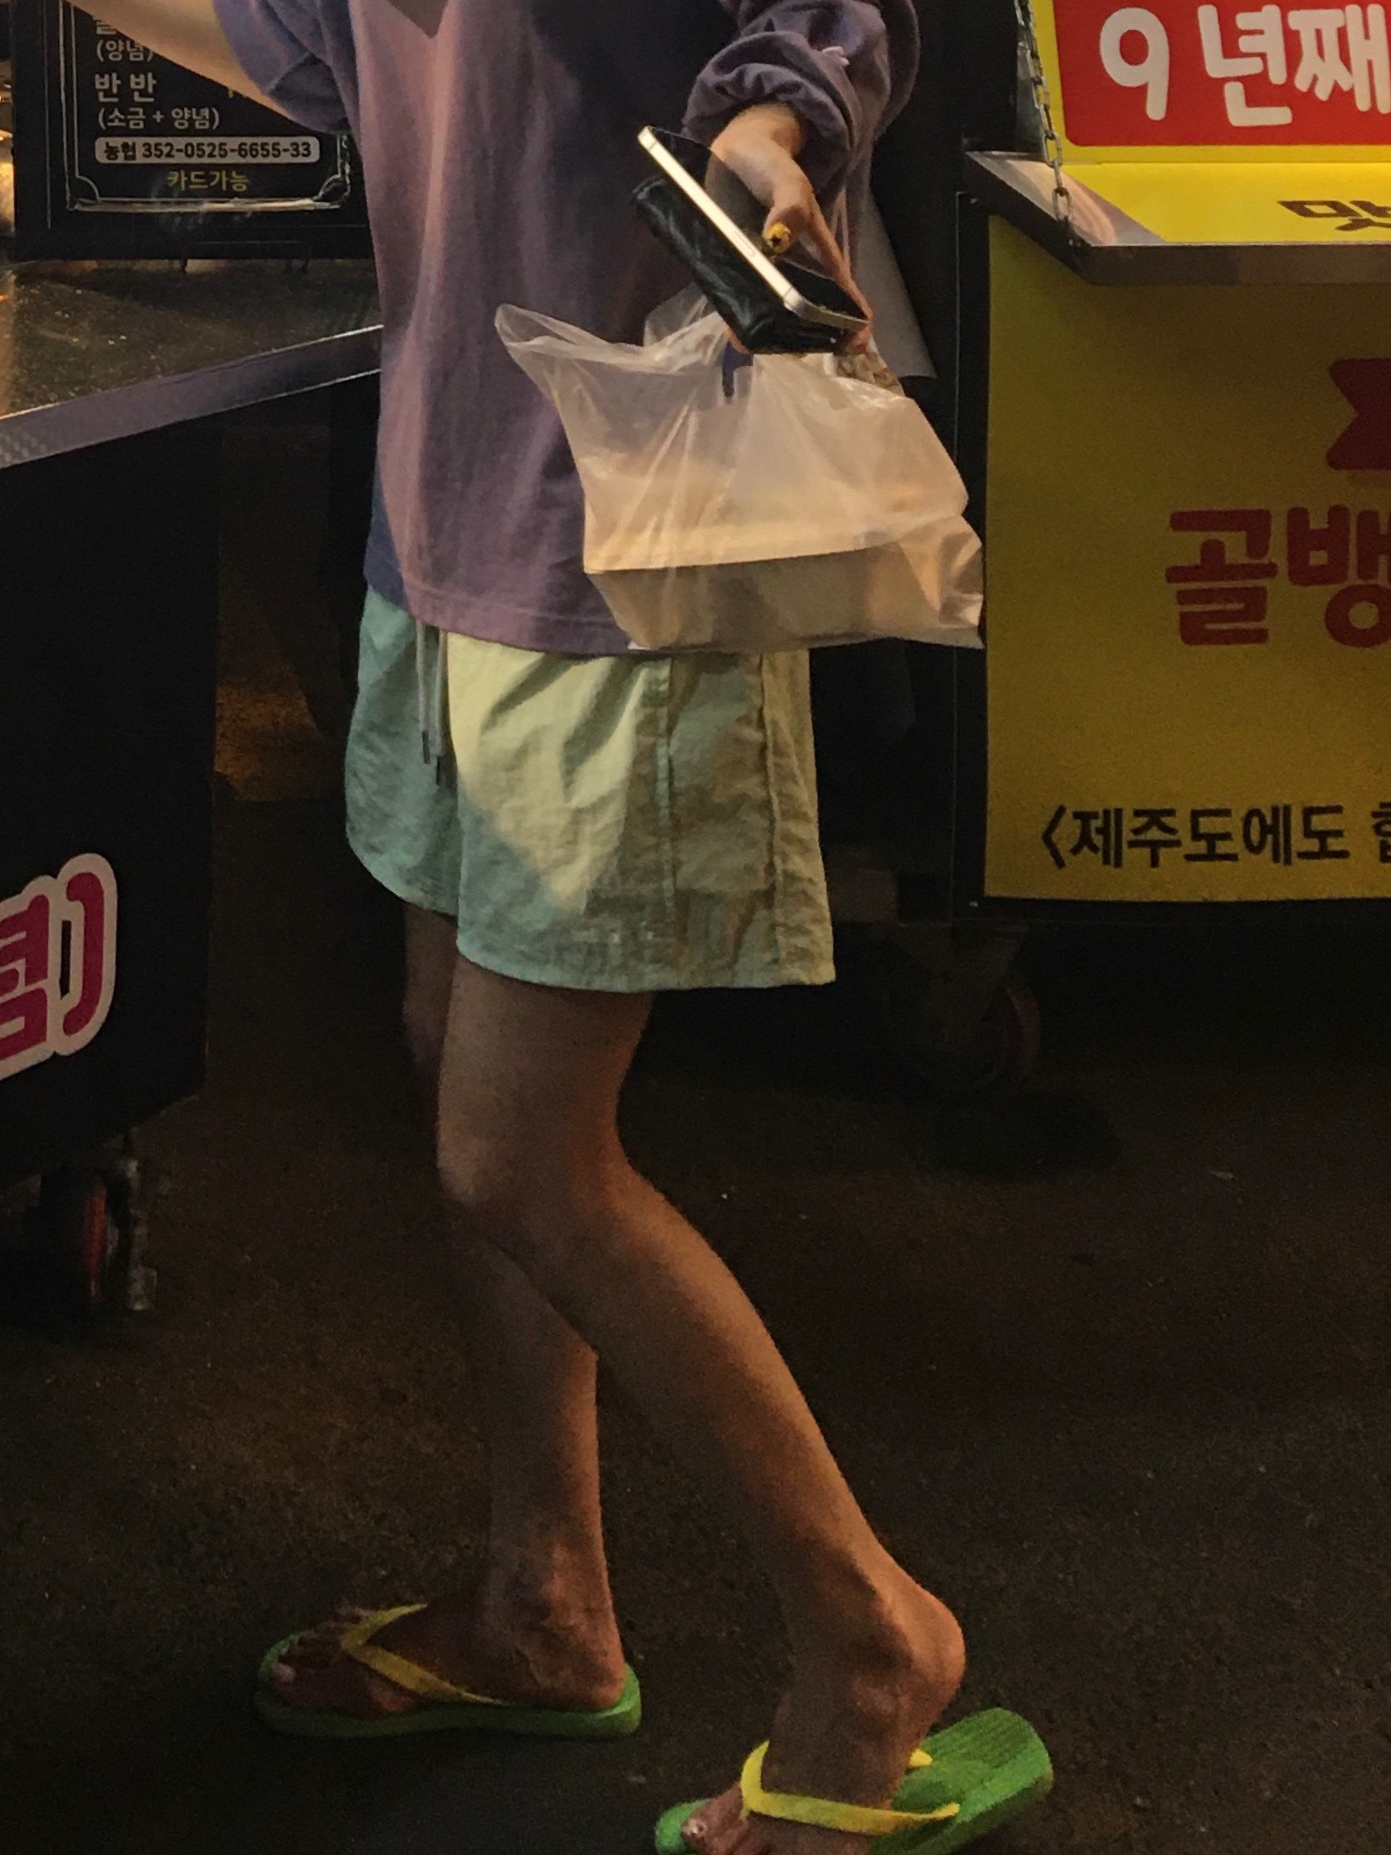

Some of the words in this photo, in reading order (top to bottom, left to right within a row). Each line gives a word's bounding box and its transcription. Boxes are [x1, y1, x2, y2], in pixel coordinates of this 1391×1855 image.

[96, 39, 155, 63] (양념)
[1099, 7, 1170, 121] 9
[1197, 3, 1391, 127] 년째
[103, 141, 137, 161] 농협
[142, 141, 312, 159] 352-0525-6655-33
[167, 169, 250, 192] 카드가능
